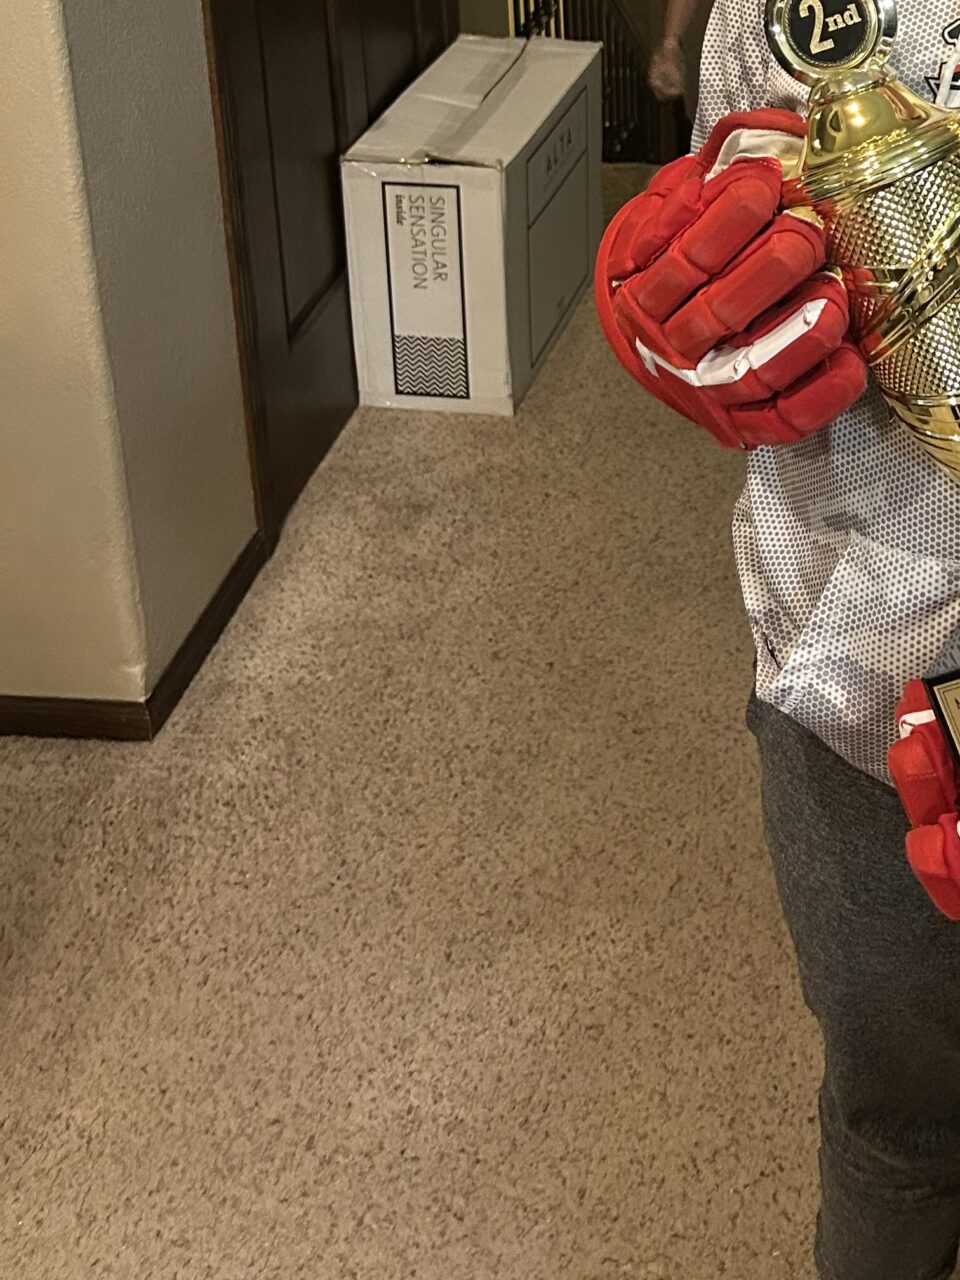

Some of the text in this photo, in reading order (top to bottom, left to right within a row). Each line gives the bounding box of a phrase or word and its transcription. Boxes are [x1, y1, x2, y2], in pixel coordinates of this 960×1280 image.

[395, 194, 406, 226] inside
[409, 194, 428, 289] SENSATION
[430, 197, 448, 281] SINGULAR
